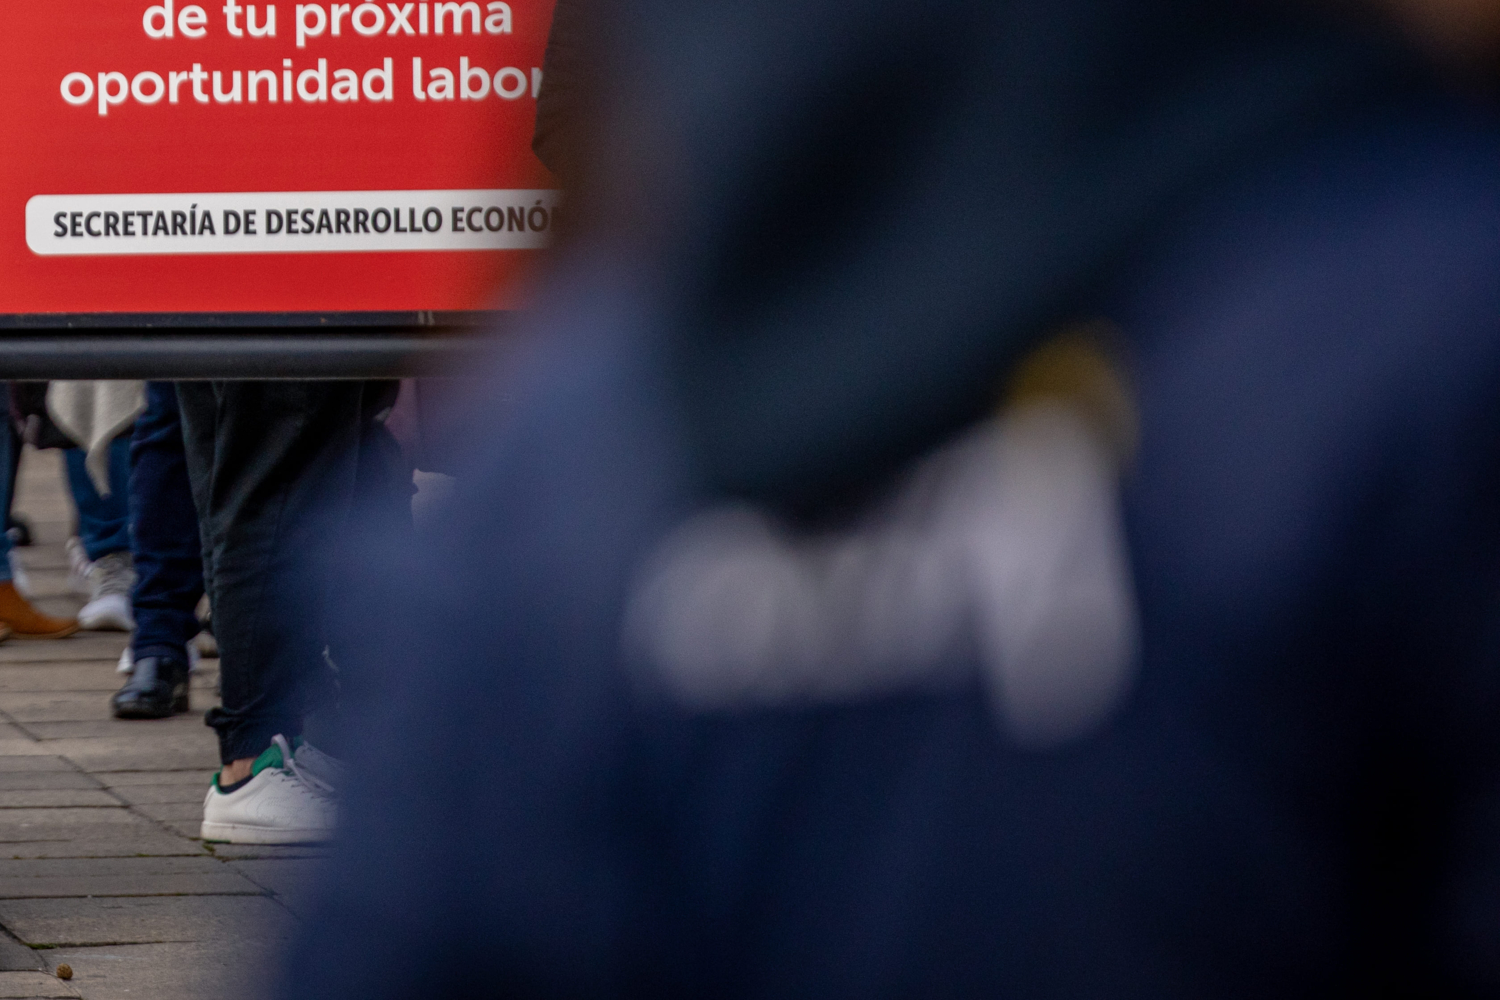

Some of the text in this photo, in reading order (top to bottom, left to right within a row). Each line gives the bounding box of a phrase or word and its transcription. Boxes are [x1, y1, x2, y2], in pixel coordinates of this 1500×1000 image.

[60, 57, 393, 115] oportunidad
[53, 200, 562, 238] SECRETARÍA DE DESARROLLO ECONÓ
